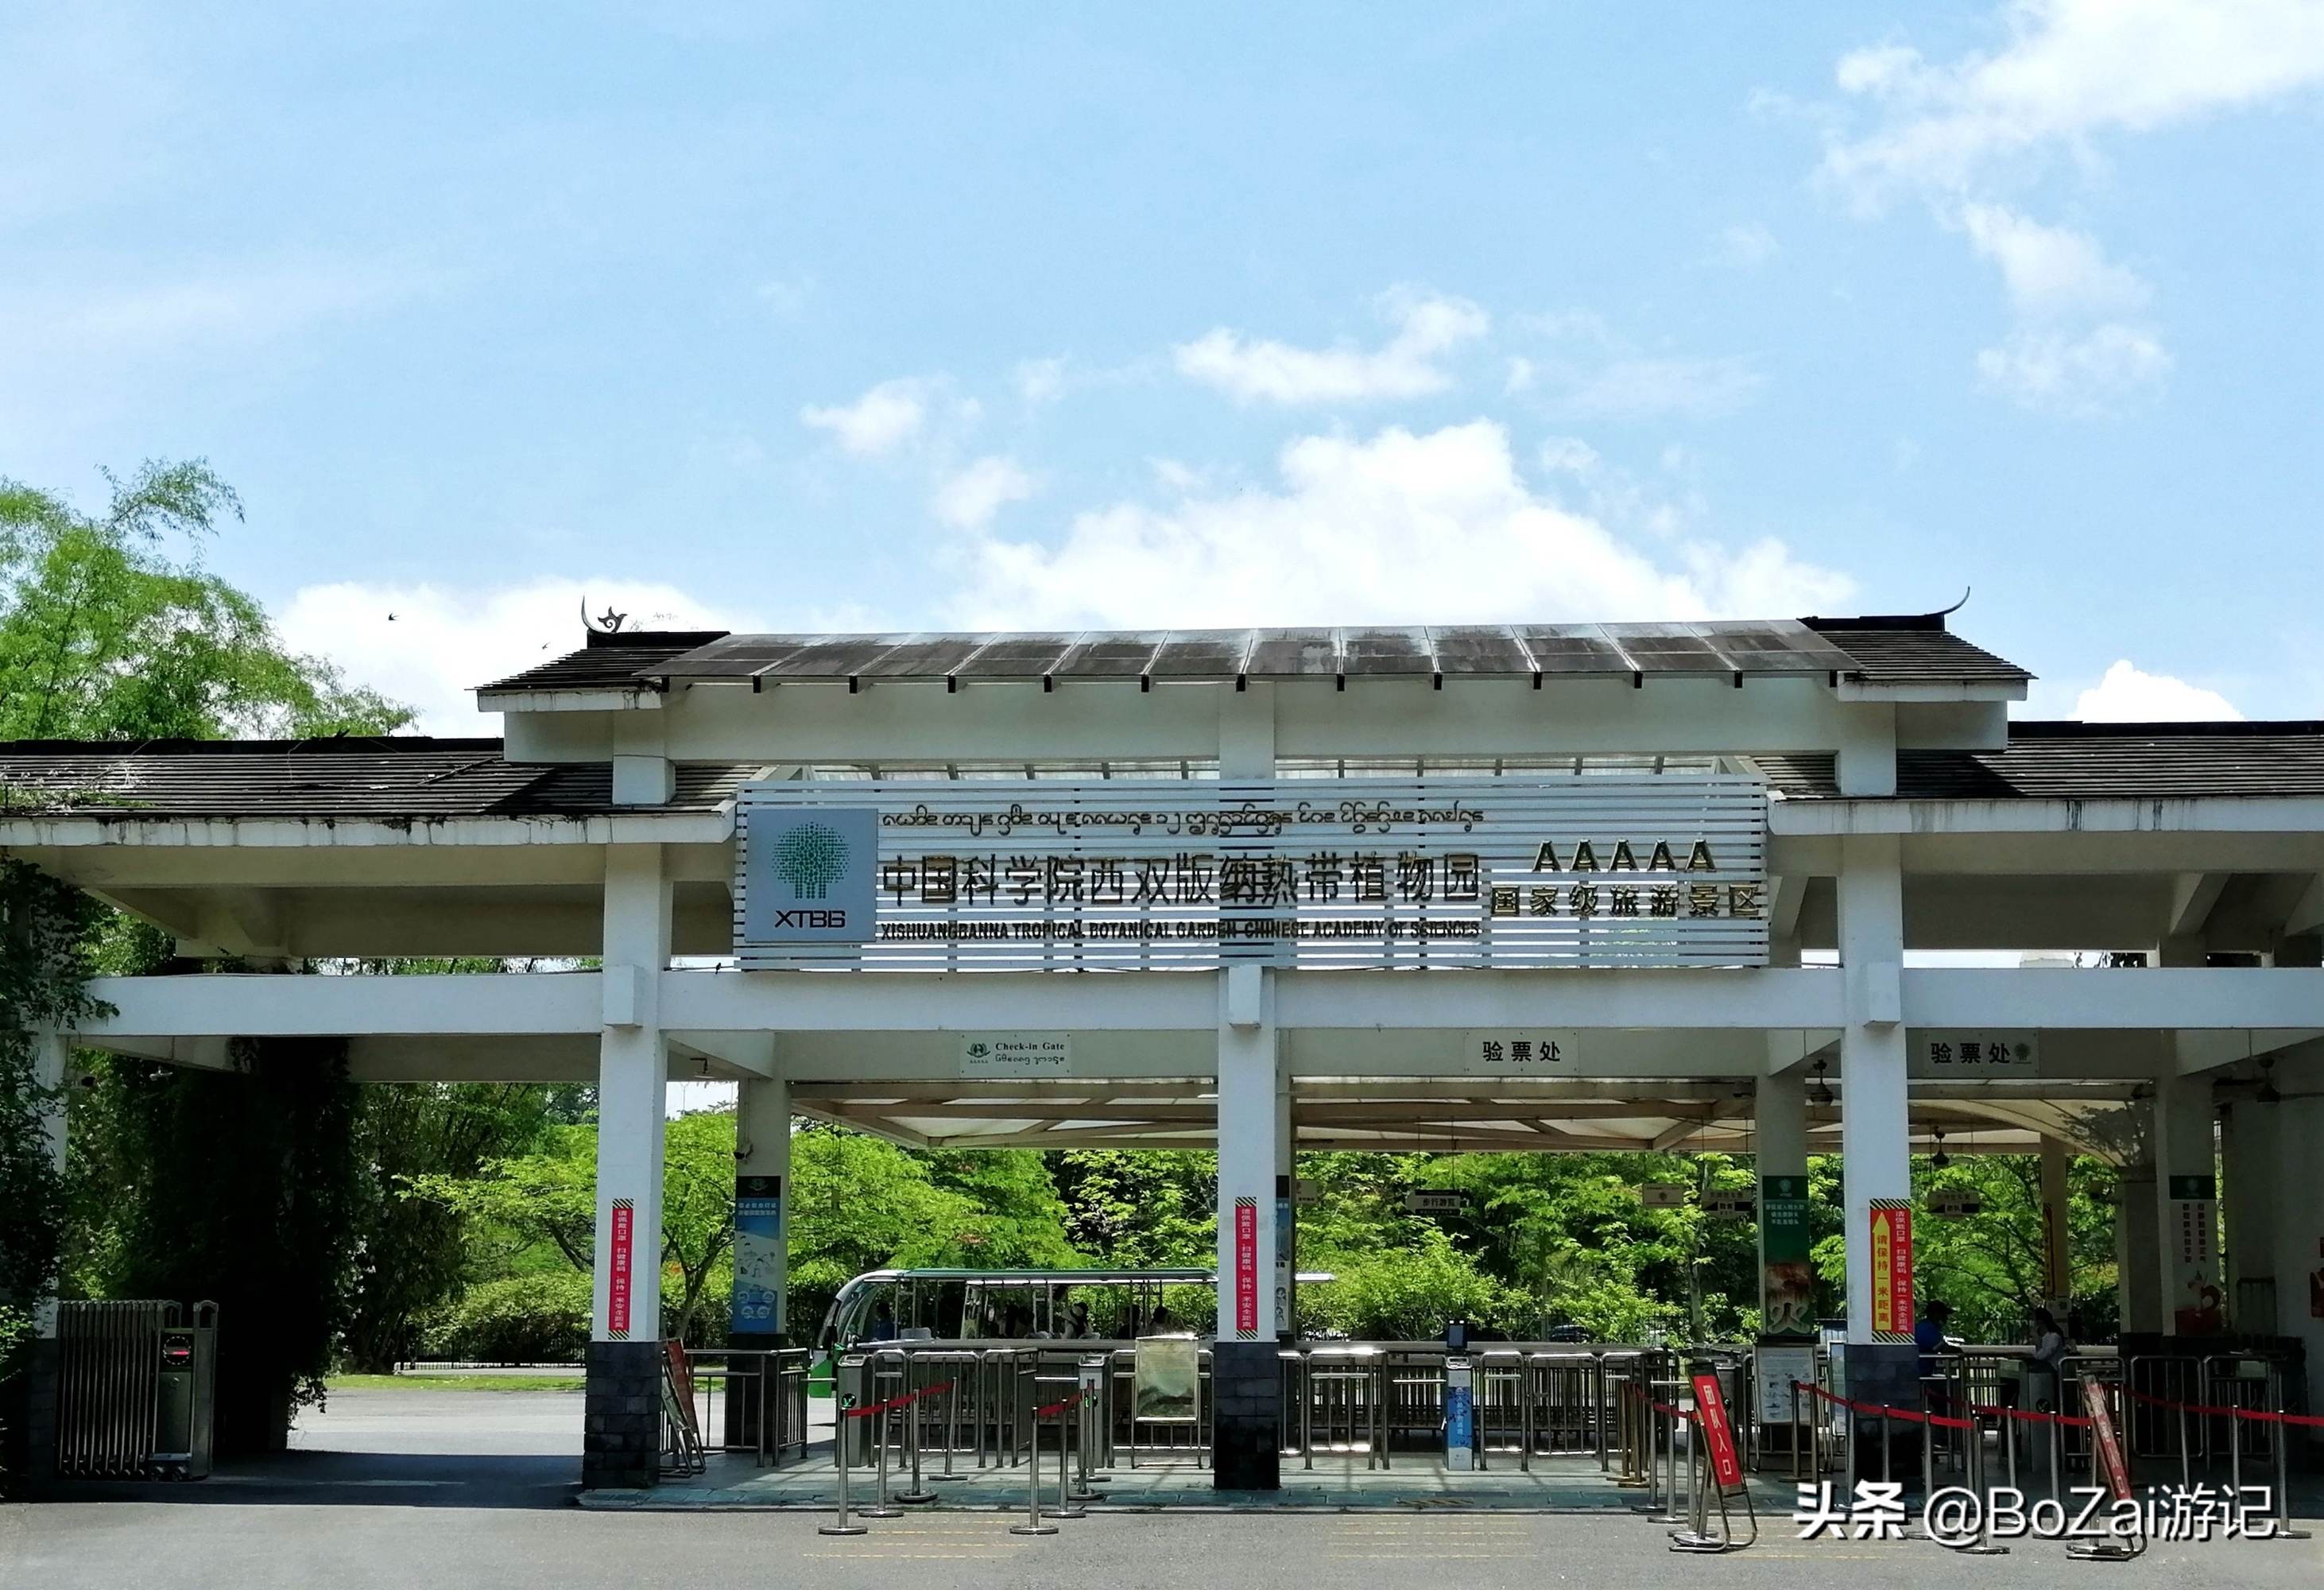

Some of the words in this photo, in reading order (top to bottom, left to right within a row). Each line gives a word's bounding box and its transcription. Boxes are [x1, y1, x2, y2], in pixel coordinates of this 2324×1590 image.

[883, 851, 1479, 906] 中国科学院西双版纳热带植物园
[1491, 884, 1759, 917] 国家级旅游景区
[774, 910, 846, 928] XTBG
[881, 923, 1007, 940] XISHUANGBANNA
[1012, 923, 1085, 940] TROPICAL
[1089, 922, 1170, 939] BOTANICAL
[1245, 922, 1310, 938] CHINESE
[1313, 921, 1385, 938] ACADEMY
[1410, 921, 1479, 937] SCIENCES
[1482, 1041, 1560, 1061] 验票处
[1931, 1043, 2010, 1064] 验票处
[1877, 1234, 1889, 1323] 请保持一米距离
[1702, 1384, 1732, 1476] 团队入口
